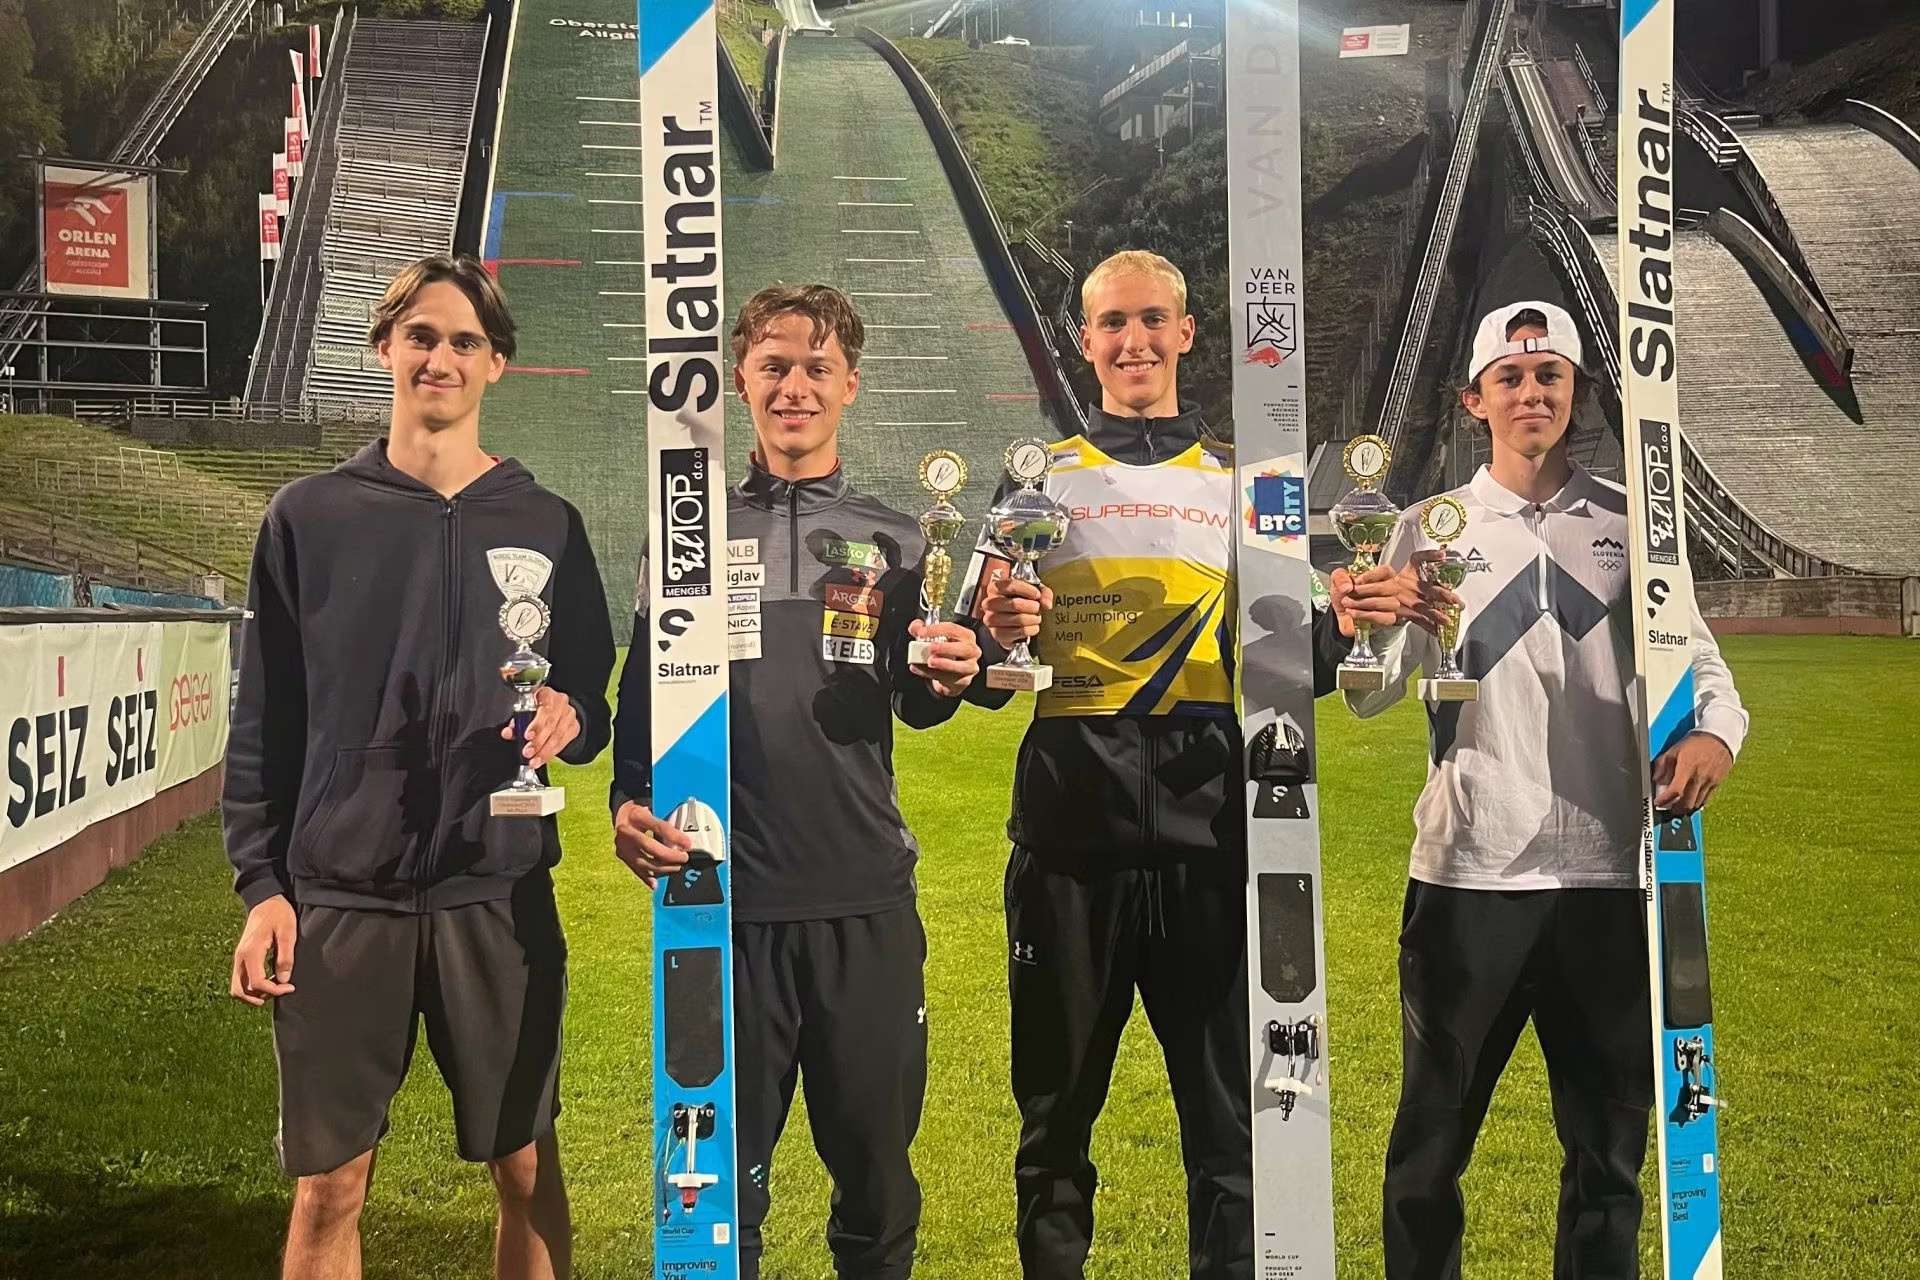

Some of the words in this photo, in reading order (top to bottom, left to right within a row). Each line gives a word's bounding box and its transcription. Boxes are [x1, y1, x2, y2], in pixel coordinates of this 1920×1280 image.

[1247, 106, 1283, 219] VAN
[58, 229, 117, 246] ORLEN
[1628, 88, 1675, 382] Slatnar
[65, 246, 111, 258] ARENA
[648, 115, 719, 413] Slatnar
[1250, 268, 1289, 280] VAN
[1246, 282, 1295, 294] DEER
[1070, 503, 1228, 529] SUPERSNOW
[1259, 514, 1302, 531] BTC
[1592, 550, 1625, 558] SLOVENIA
[832, 590, 877, 607] ARGETA
[1055, 594, 1122, 608] Alpencup
[1055, 611, 1070, 625] Ski
[1073, 610, 1137, 624] Jumping
[1055, 631, 1083, 642] Men
[1648, 629, 1688, 647] Slatnar
[840, 641, 873, 660] ELES
[658, 663, 720, 677] Slatnar
[106, 690, 157, 787] SEIZ
[7, 705, 88, 828] SEIZ
[671, 955, 679, 969] L
[1672, 1188, 1706, 1200] Improving
[1672, 1201, 1688, 1210] Your
[662, 1259, 717, 1271] Improving
